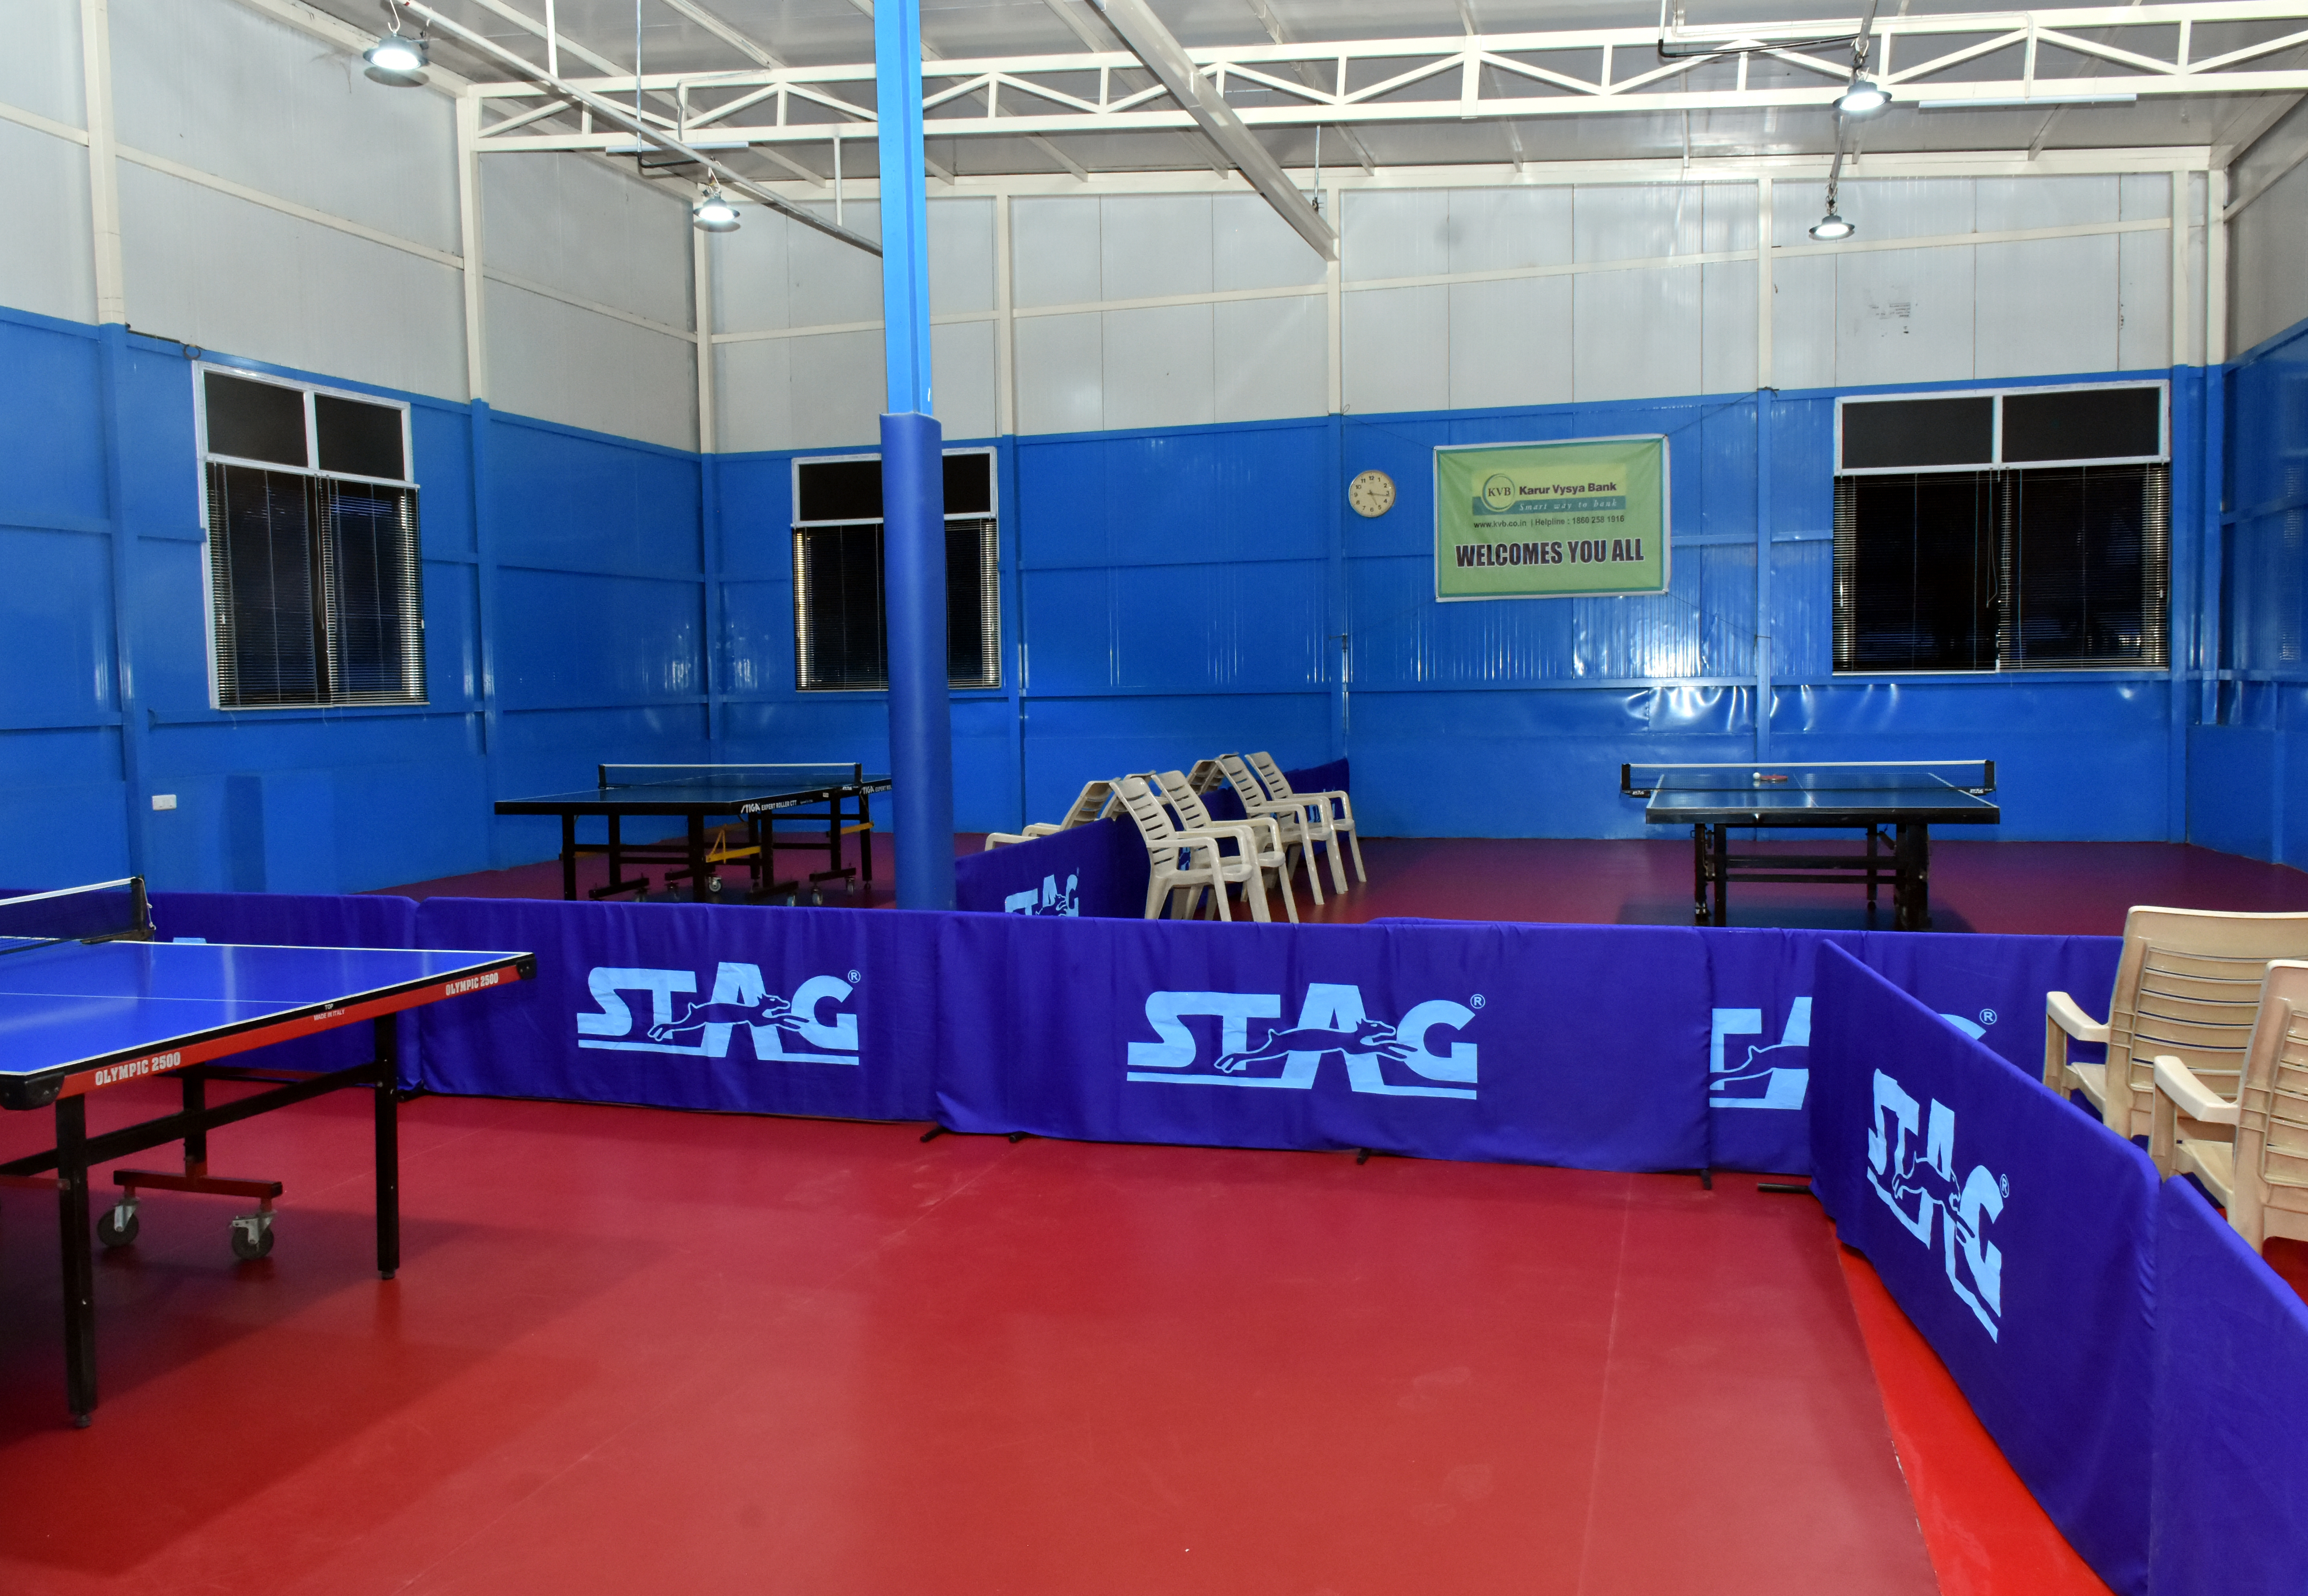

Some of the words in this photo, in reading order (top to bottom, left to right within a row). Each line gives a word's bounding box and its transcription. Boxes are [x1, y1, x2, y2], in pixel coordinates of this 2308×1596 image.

[1488, 487, 1511, 497] KVB
[1519, 486, 1550, 495] Karur
[1553, 484, 1585, 496] Vysya
[1588, 482, 1617, 492] Bank
[1594, 499, 1617, 507] bank
[1473, 520, 1527, 528] www.kvb.co.in
[1535, 518, 1565, 526] Helpline
[1455, 541, 1563, 567] WELCOMES
[1567, 539, 1607, 564] YOU
[1611, 538, 1644, 562] ALL
[741, 803, 761, 814] STIGA
[446, 977, 479, 996] OLYMPIC
[480, 972, 499, 987] 2500
[314, 1013, 327, 1021] MADE
[576, 962, 859, 1065] STAG
[1126, 982, 1478, 1100] STAG
[95, 1059, 149, 1086] OLYMPIC
[152, 1052, 181, 1072] 2500
[1867, 1067, 2004, 1344] STAG
